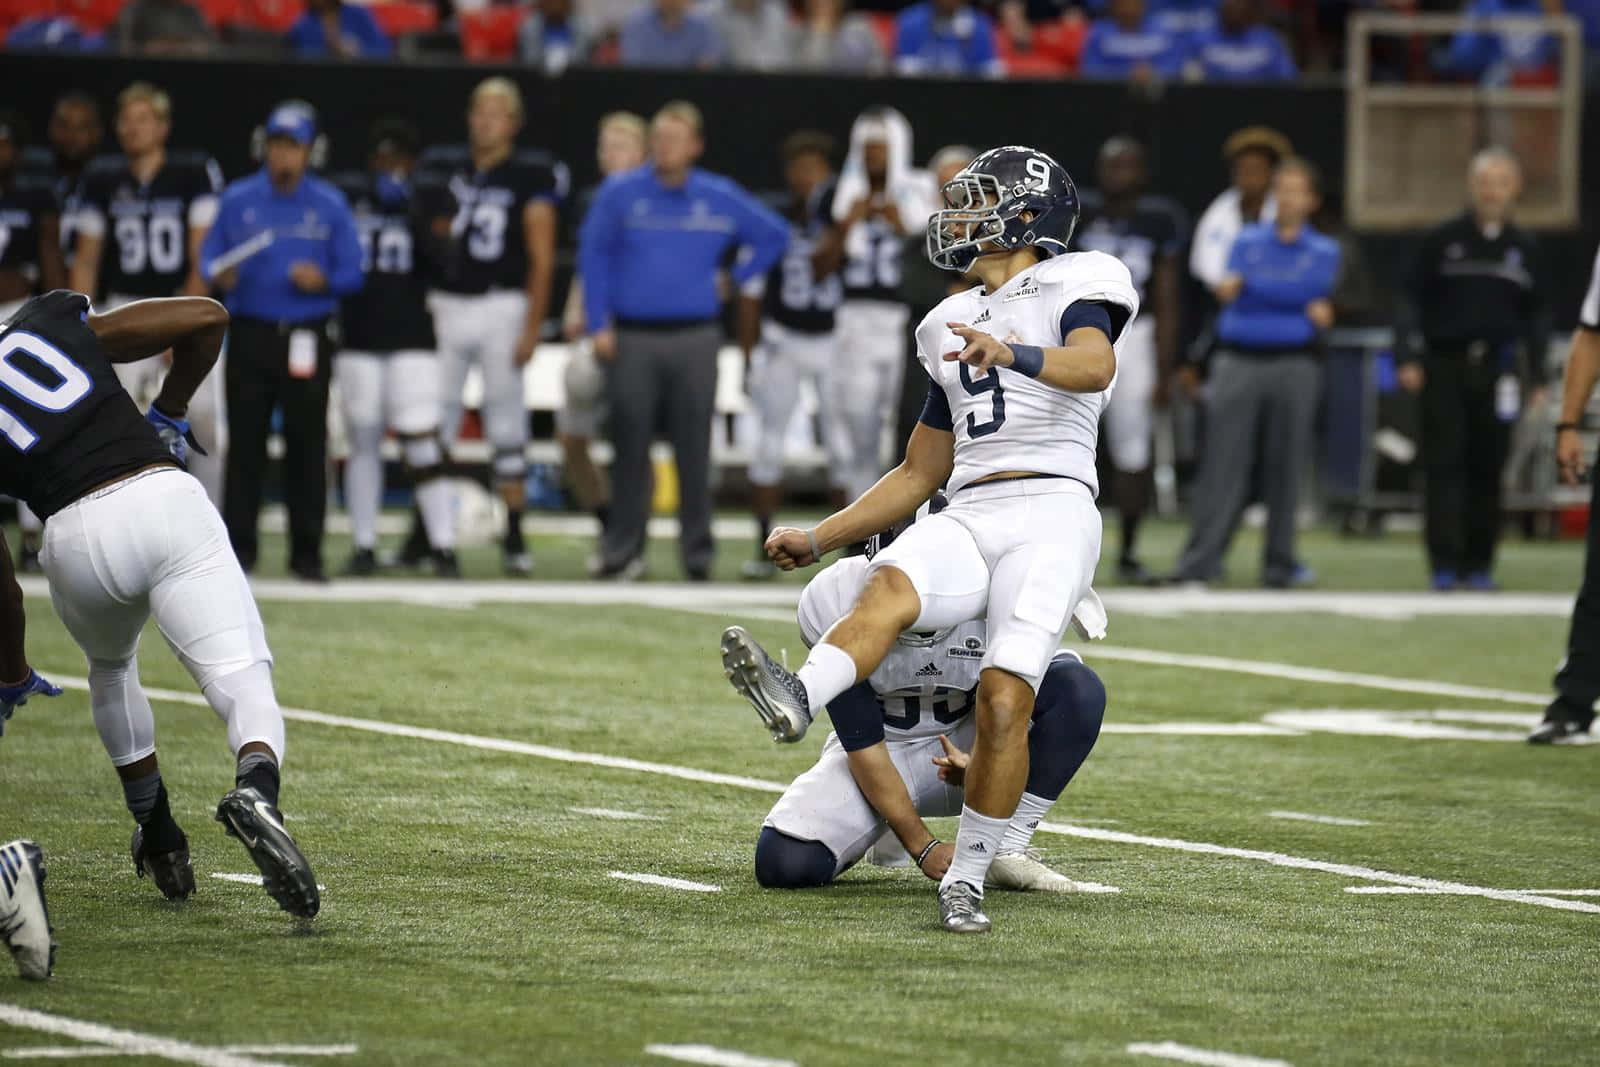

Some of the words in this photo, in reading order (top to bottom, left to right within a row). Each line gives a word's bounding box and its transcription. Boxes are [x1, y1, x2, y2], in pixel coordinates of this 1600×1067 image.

[1024, 158, 1050, 193] 9
[114, 215, 184, 275] 90
[959, 360, 1007, 440] 9
[949, 648, 970, 657] SUN
